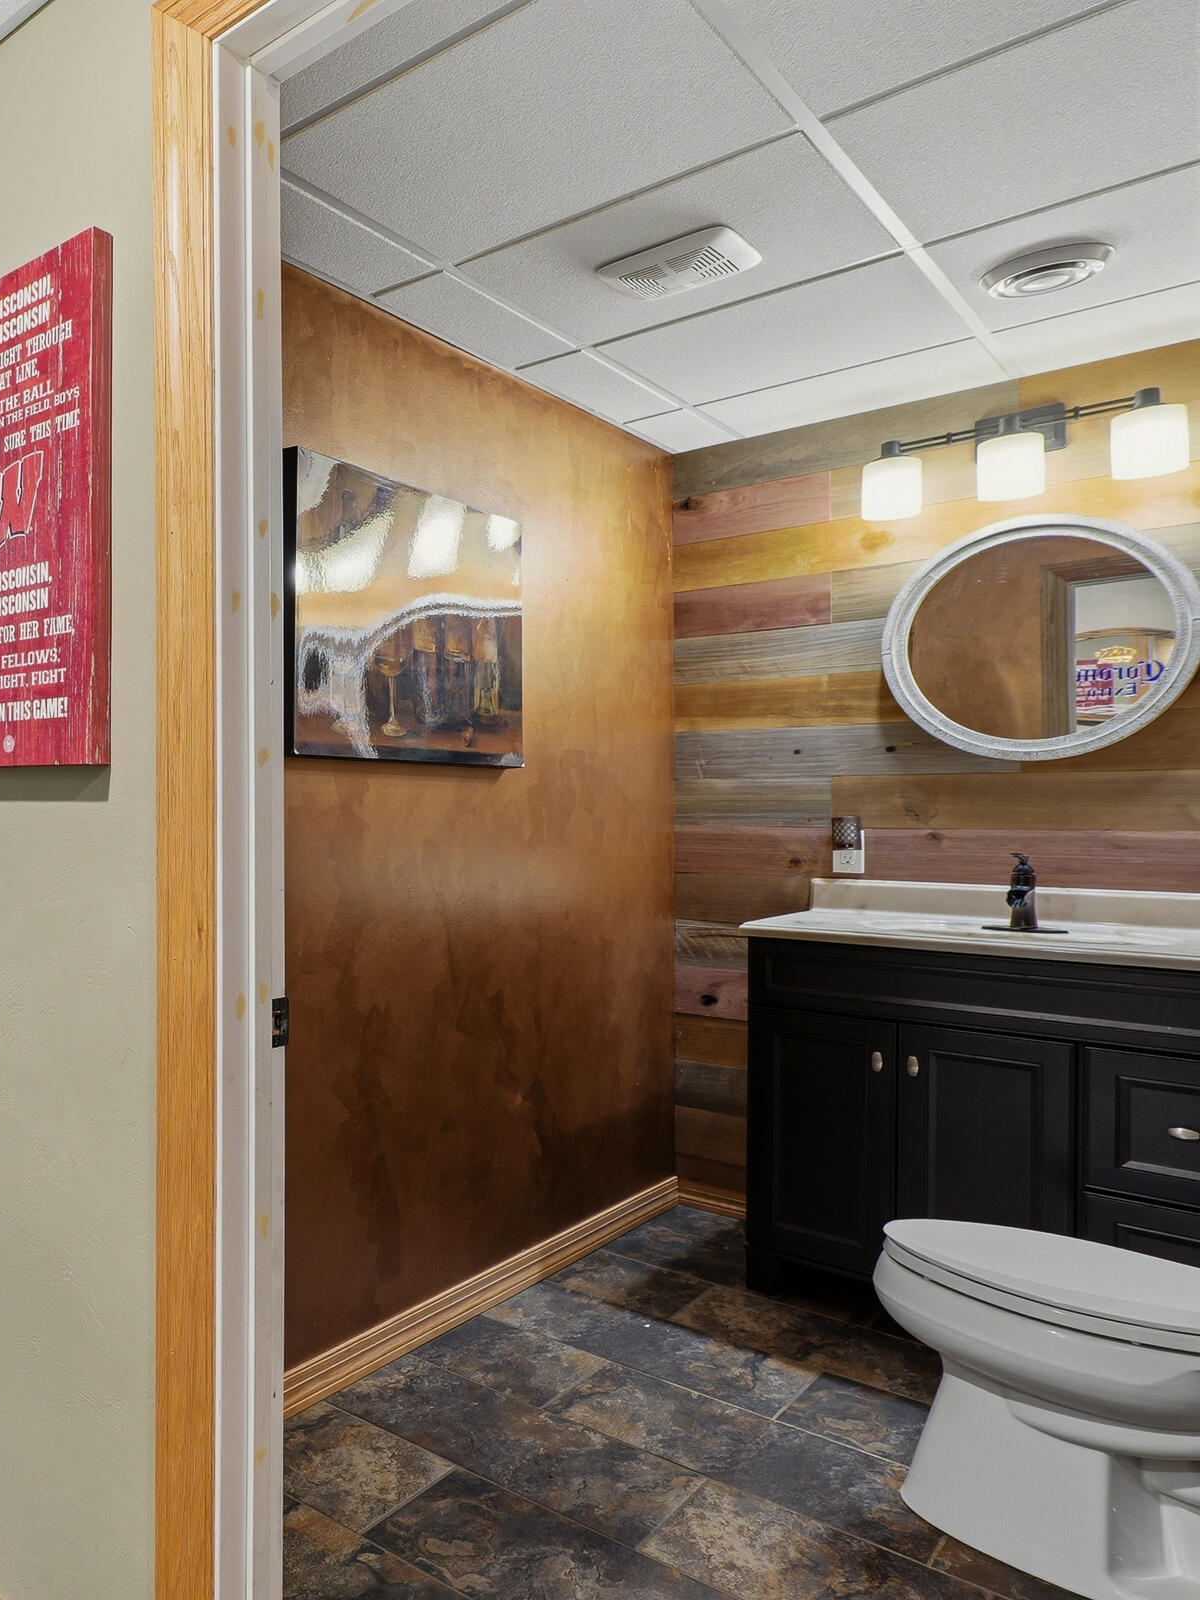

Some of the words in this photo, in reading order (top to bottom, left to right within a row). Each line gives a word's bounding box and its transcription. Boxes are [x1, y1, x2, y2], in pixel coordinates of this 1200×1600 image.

[25, 319, 73, 357] THROUGH
[15, 357, 40, 384] LINE,
[23, 379, 55, 405] BALL
[6, 409, 24, 425] THE
[54, 386, 80, 406] BOYS
[4, 429, 27, 452] SURE
[30, 419, 52, 443] THIS
[55, 408, 80, 434] TIME
[19, 620, 39, 640] HER
[43, 614, 75, 637] FAME,
[31, 667, 67, 686] FIGHT
[7, 700, 31, 722] THIS
[32, 697, 68, 720] GAME!
